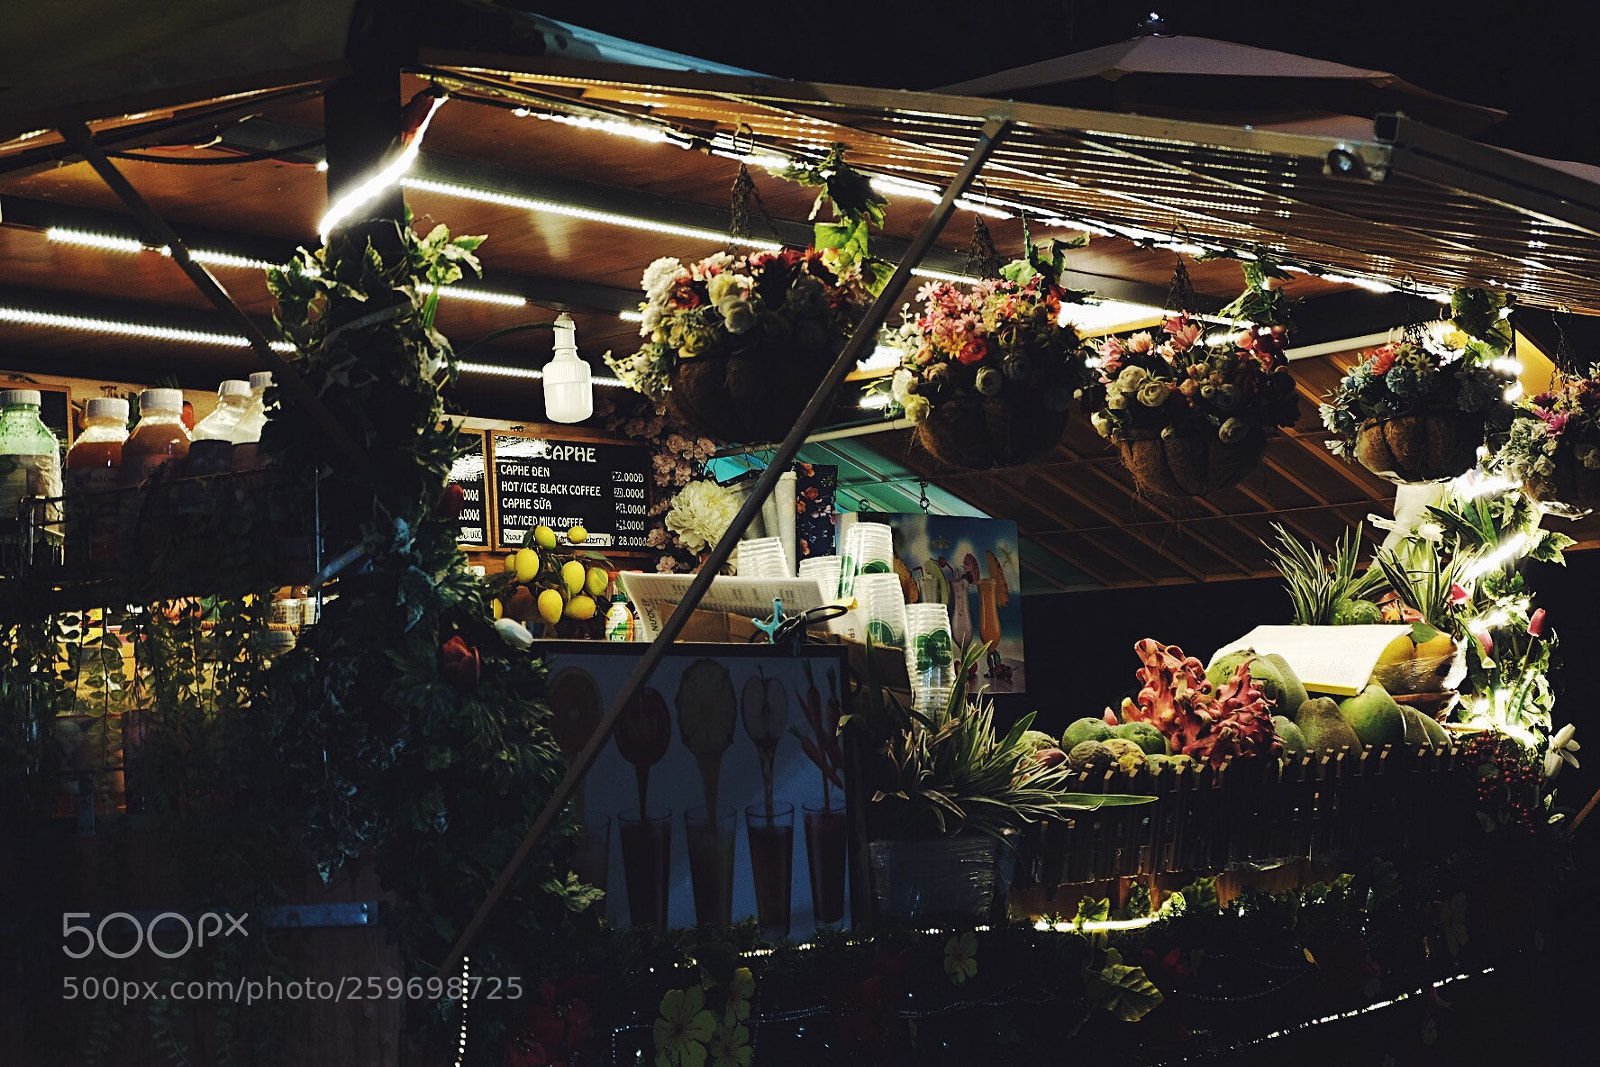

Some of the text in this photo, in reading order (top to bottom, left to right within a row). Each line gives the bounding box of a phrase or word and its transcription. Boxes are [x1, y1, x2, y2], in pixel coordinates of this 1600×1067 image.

[543, 446, 597, 463] CAPHE
[501, 465, 530, 477] CAPHE
[501, 481, 538, 494] HOT/ICE
[540, 483, 568, 496] BLACK
[569, 485, 601, 497] COFFEE
[502, 498, 532, 510] CAPHE
[503, 515, 538, 527] HOT/ICED
[539, 516, 557, 527] MILK
[557, 517, 584, 528] COFFEE
